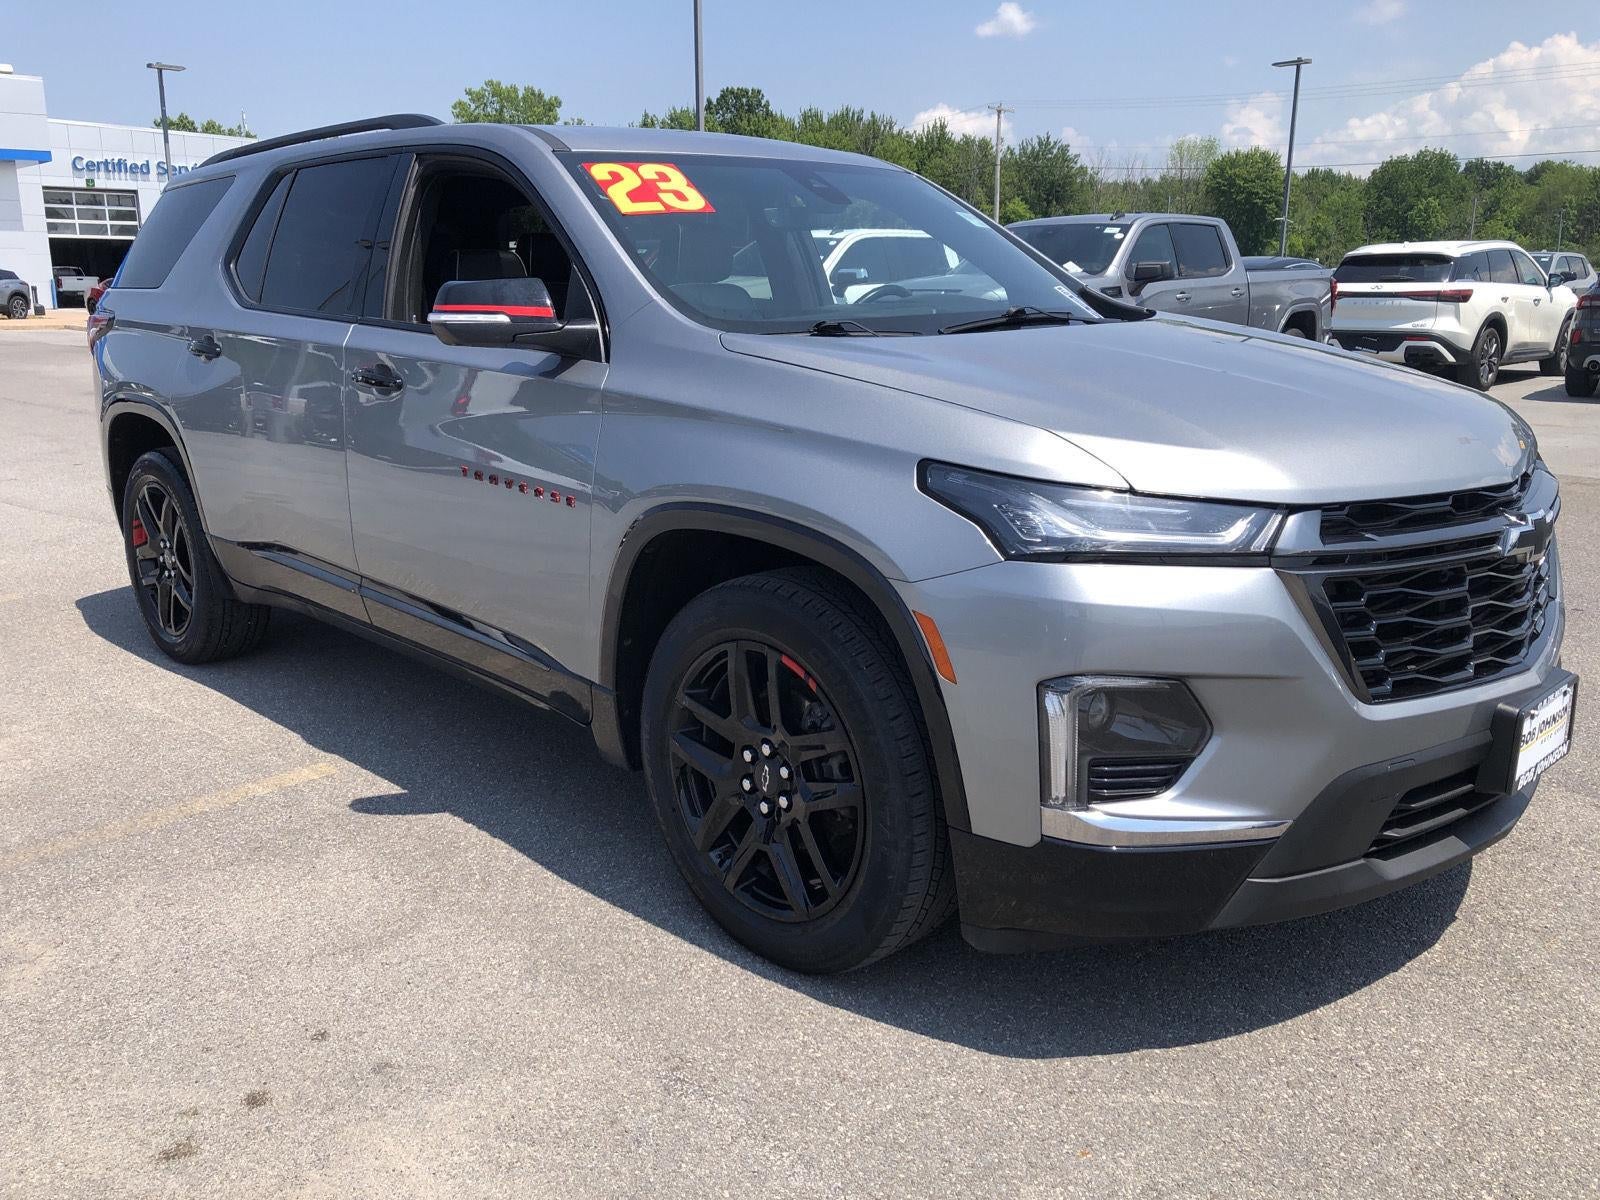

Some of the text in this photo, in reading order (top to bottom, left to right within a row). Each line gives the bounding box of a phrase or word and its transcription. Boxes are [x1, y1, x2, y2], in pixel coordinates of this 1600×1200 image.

[72, 155, 199, 176] Certified Serv
[589, 163, 706, 213] 23
[460, 465, 576, 508] TRAVERSE
[1519, 726, 1537, 748] BOB
